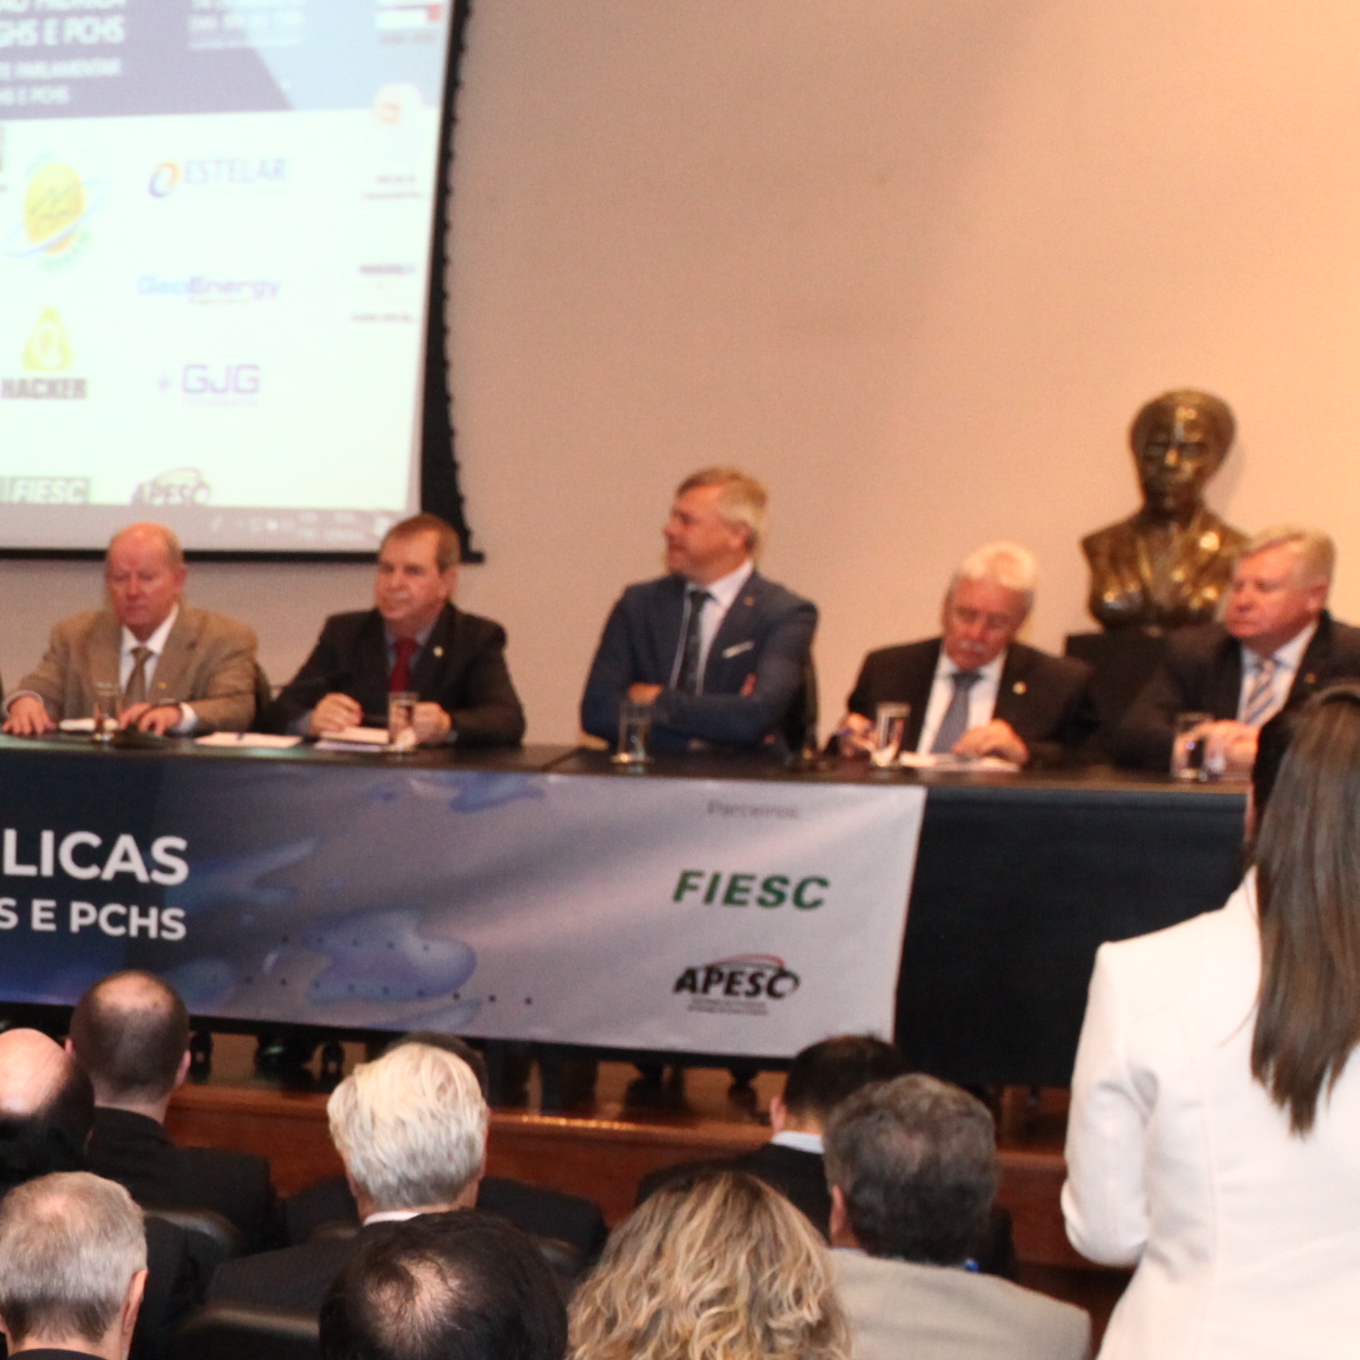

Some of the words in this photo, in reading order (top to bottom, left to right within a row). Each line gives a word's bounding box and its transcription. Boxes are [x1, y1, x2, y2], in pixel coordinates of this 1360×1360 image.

[42, 17, 59, 46] E
[62, 15, 126, 45] PCHS
[183, 158, 286, 184] ESTELAR
[0, 378, 87, 400] HACKER
[181, 363, 261, 394] GJG
[672, 868, 830, 911] FIESC
[31, 899, 57, 931] E
[69, 901, 187, 941] PCHS
[672, 964, 801, 999] APESC
